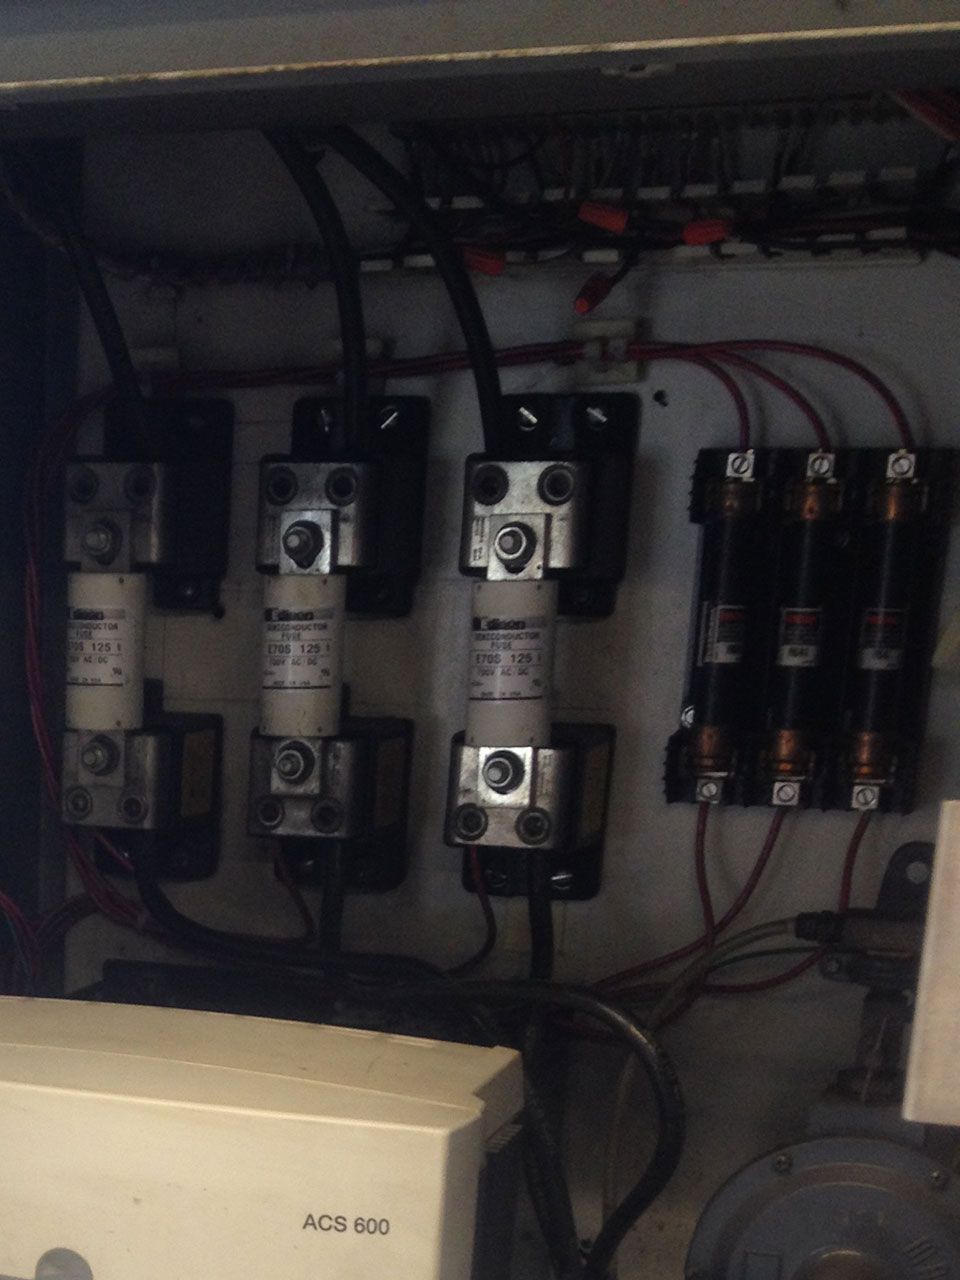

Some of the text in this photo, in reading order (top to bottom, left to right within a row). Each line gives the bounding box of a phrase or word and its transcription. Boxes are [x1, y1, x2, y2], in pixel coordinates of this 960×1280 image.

[92, 643, 111, 652] 125
[300, 644, 321, 653] 125
[510, 654, 532, 664] 125
[302, 1213, 390, 1236] ACS 600
